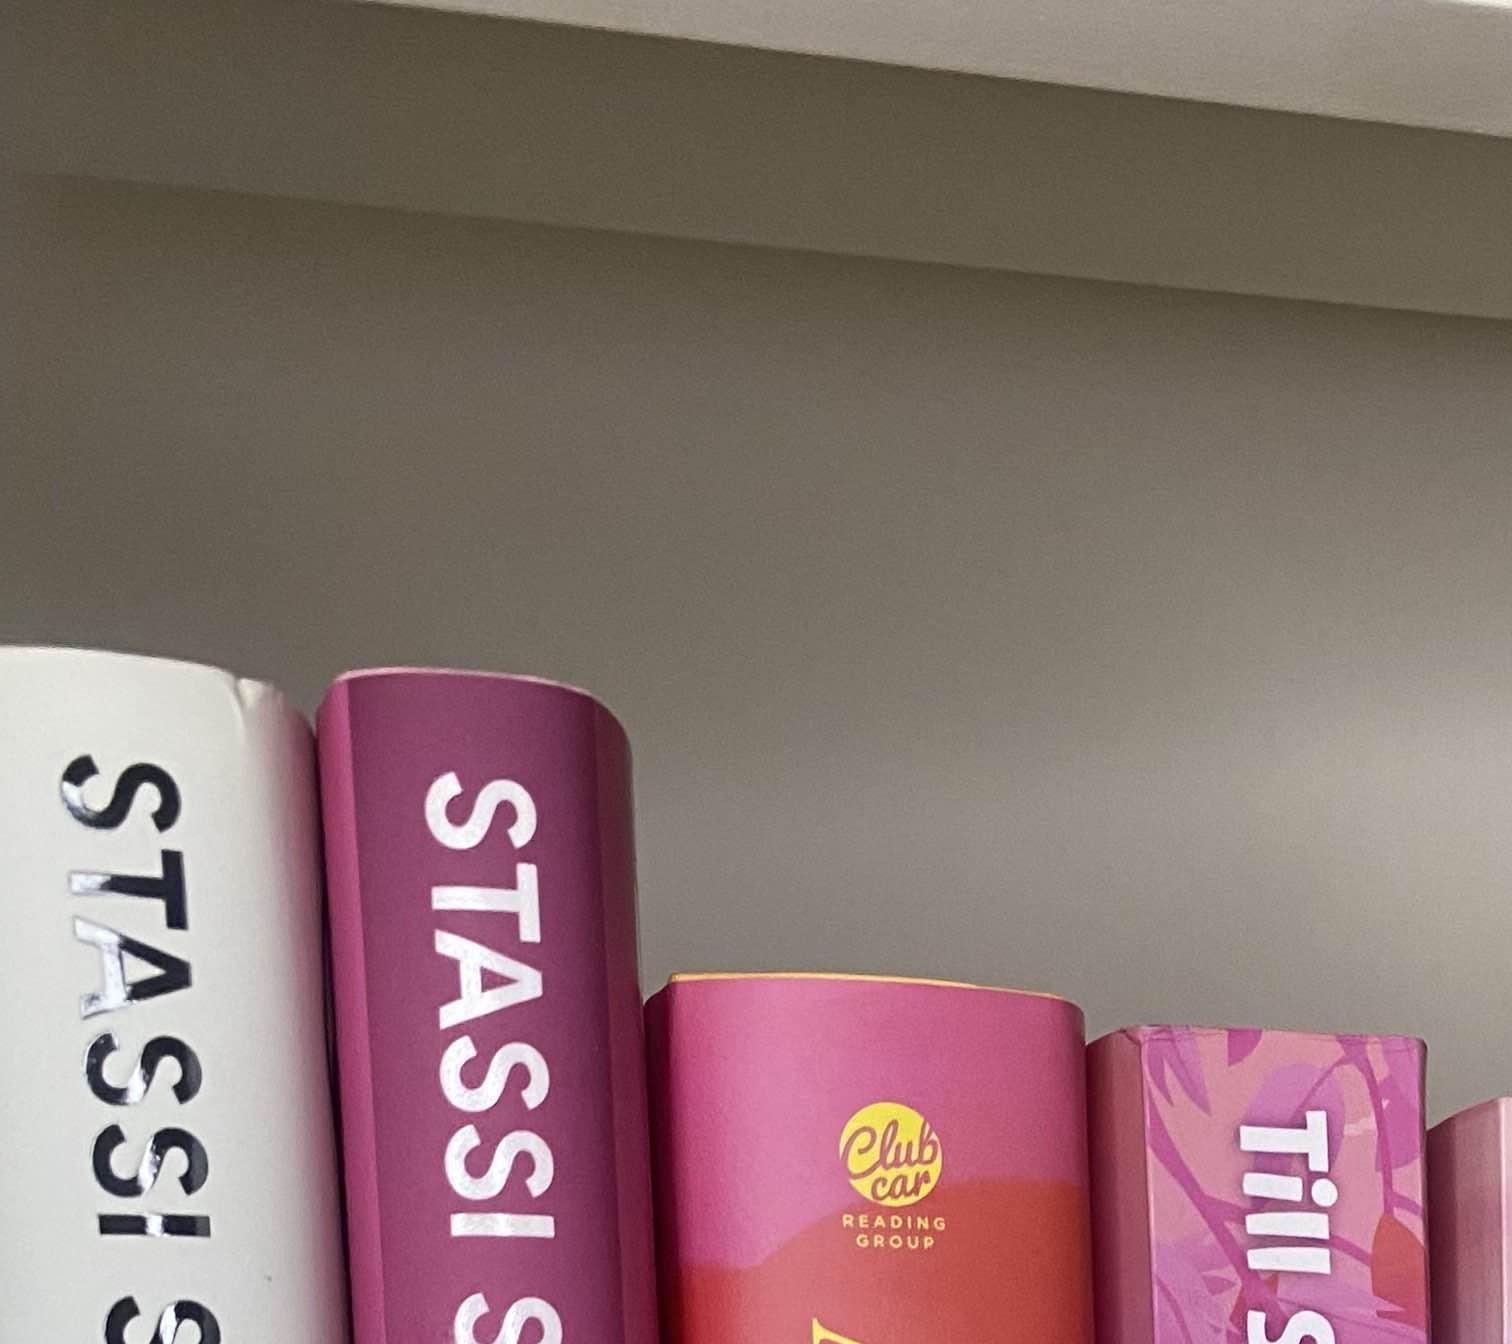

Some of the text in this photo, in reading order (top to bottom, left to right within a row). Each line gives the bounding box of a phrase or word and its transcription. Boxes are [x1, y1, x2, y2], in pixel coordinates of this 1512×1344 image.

[60, 755, 211, 1239] STASSI
[425, 771, 556, 1238] STASSI
[839, 1118, 939, 1180] Club
[871, 1170, 931, 1201] car
[1238, 1110, 1337, 1276] Till
[842, 1213, 946, 1231] READING
[856, 1233, 935, 1249] GROUP
